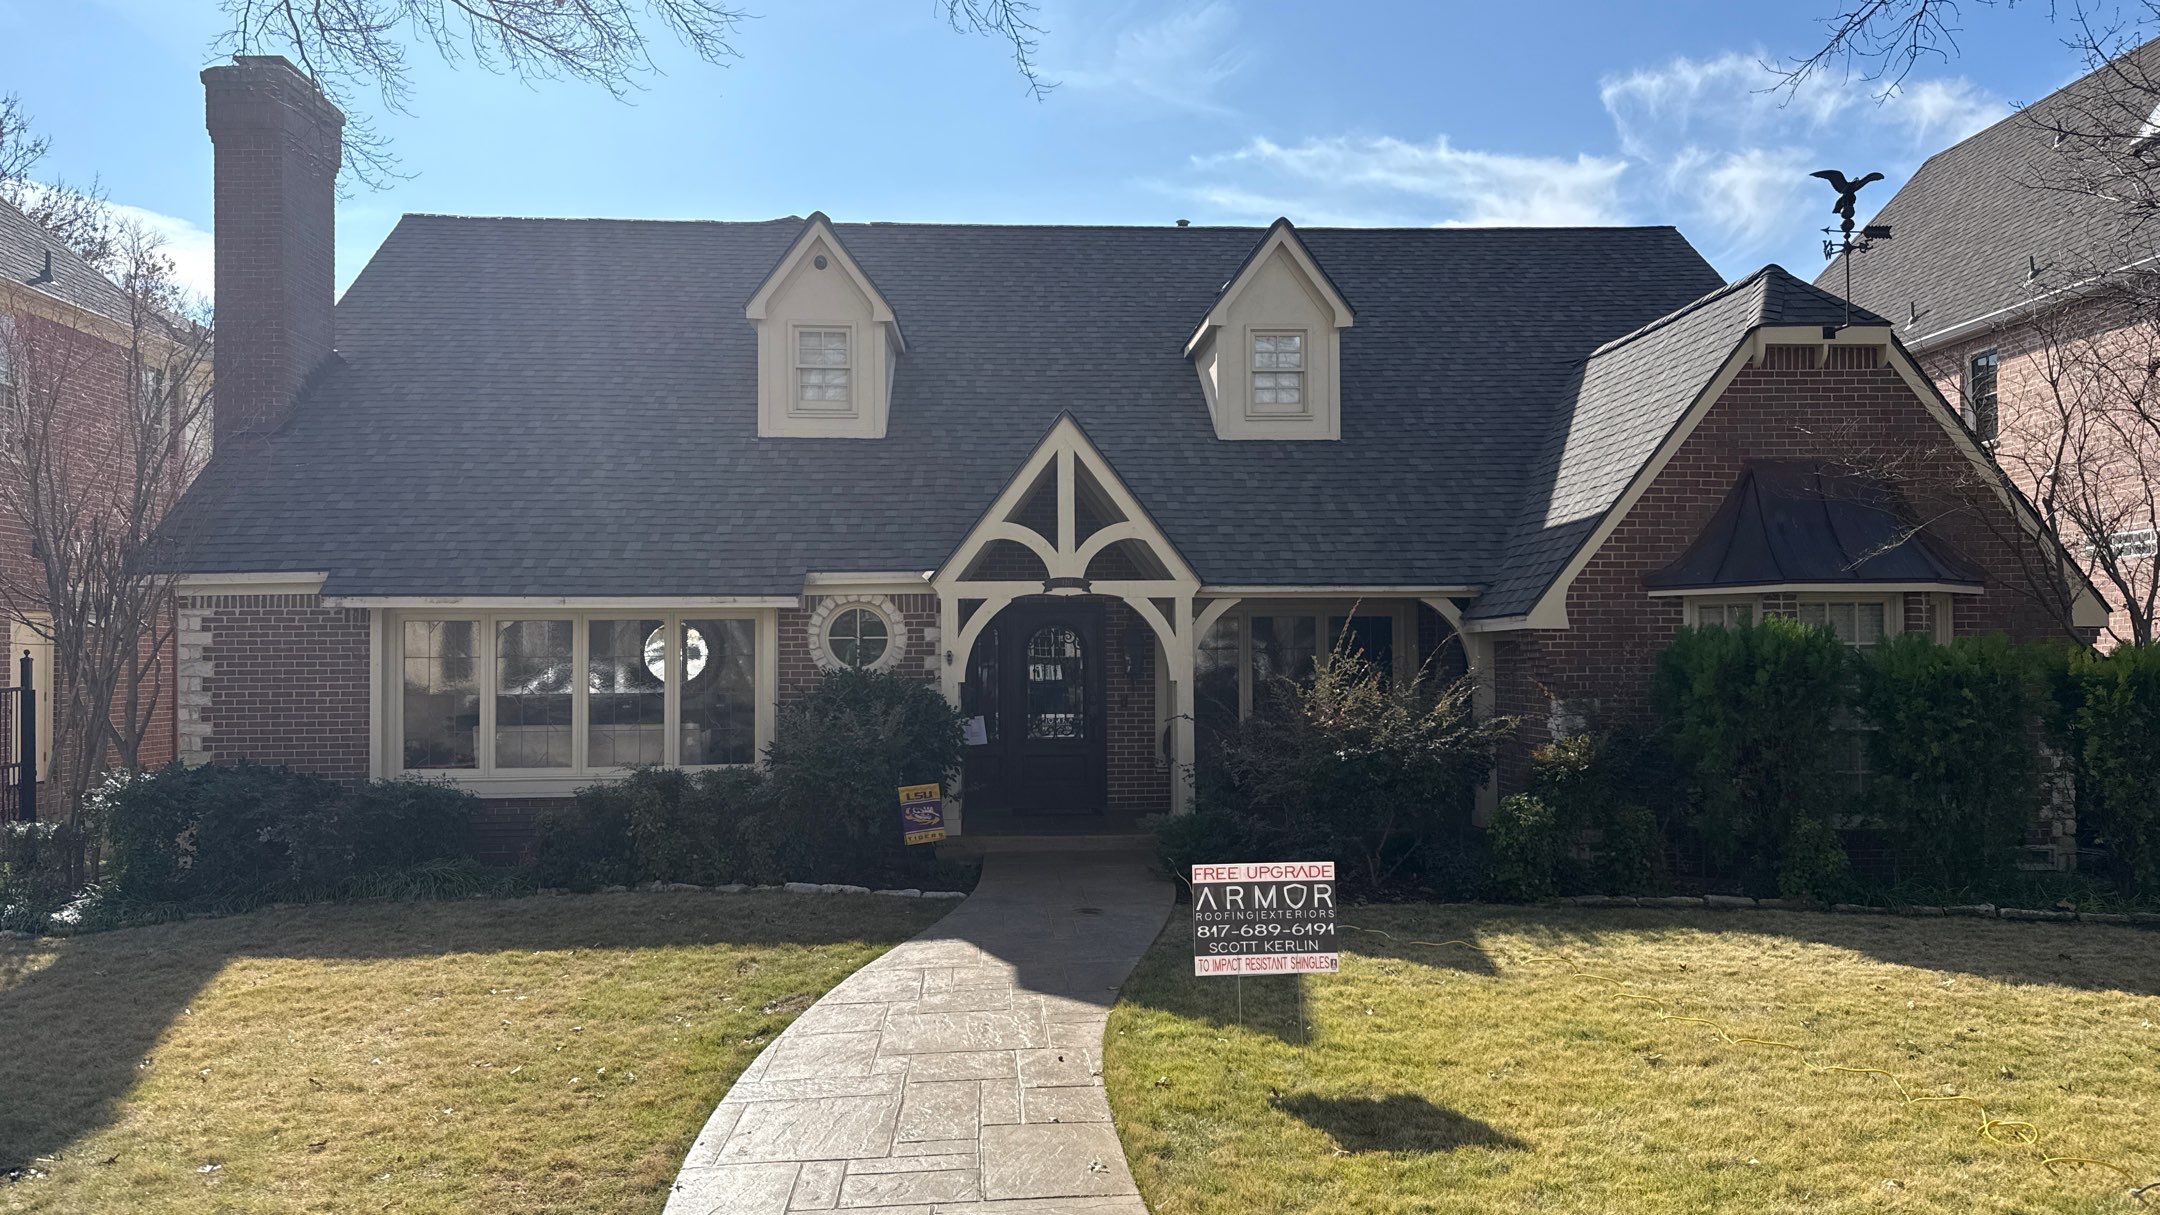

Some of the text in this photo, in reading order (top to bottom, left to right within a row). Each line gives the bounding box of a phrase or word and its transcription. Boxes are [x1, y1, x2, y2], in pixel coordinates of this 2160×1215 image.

[905, 791, 933, 801] LSU
[1194, 865, 1333, 880] FREE UPGRADE
[1195, 883, 1333, 911] ARMOR
[1197, 922, 1335, 938] 817-689-6191
[1209, 939, 1319, 953] SCOTT KERLIN
[1199, 960, 1210, 972] TO
[1212, 957, 1242, 972] IMPACT
[1246, 956, 1288, 971] RESISTANT
[1290, 955, 1330, 970] SHINGLES
